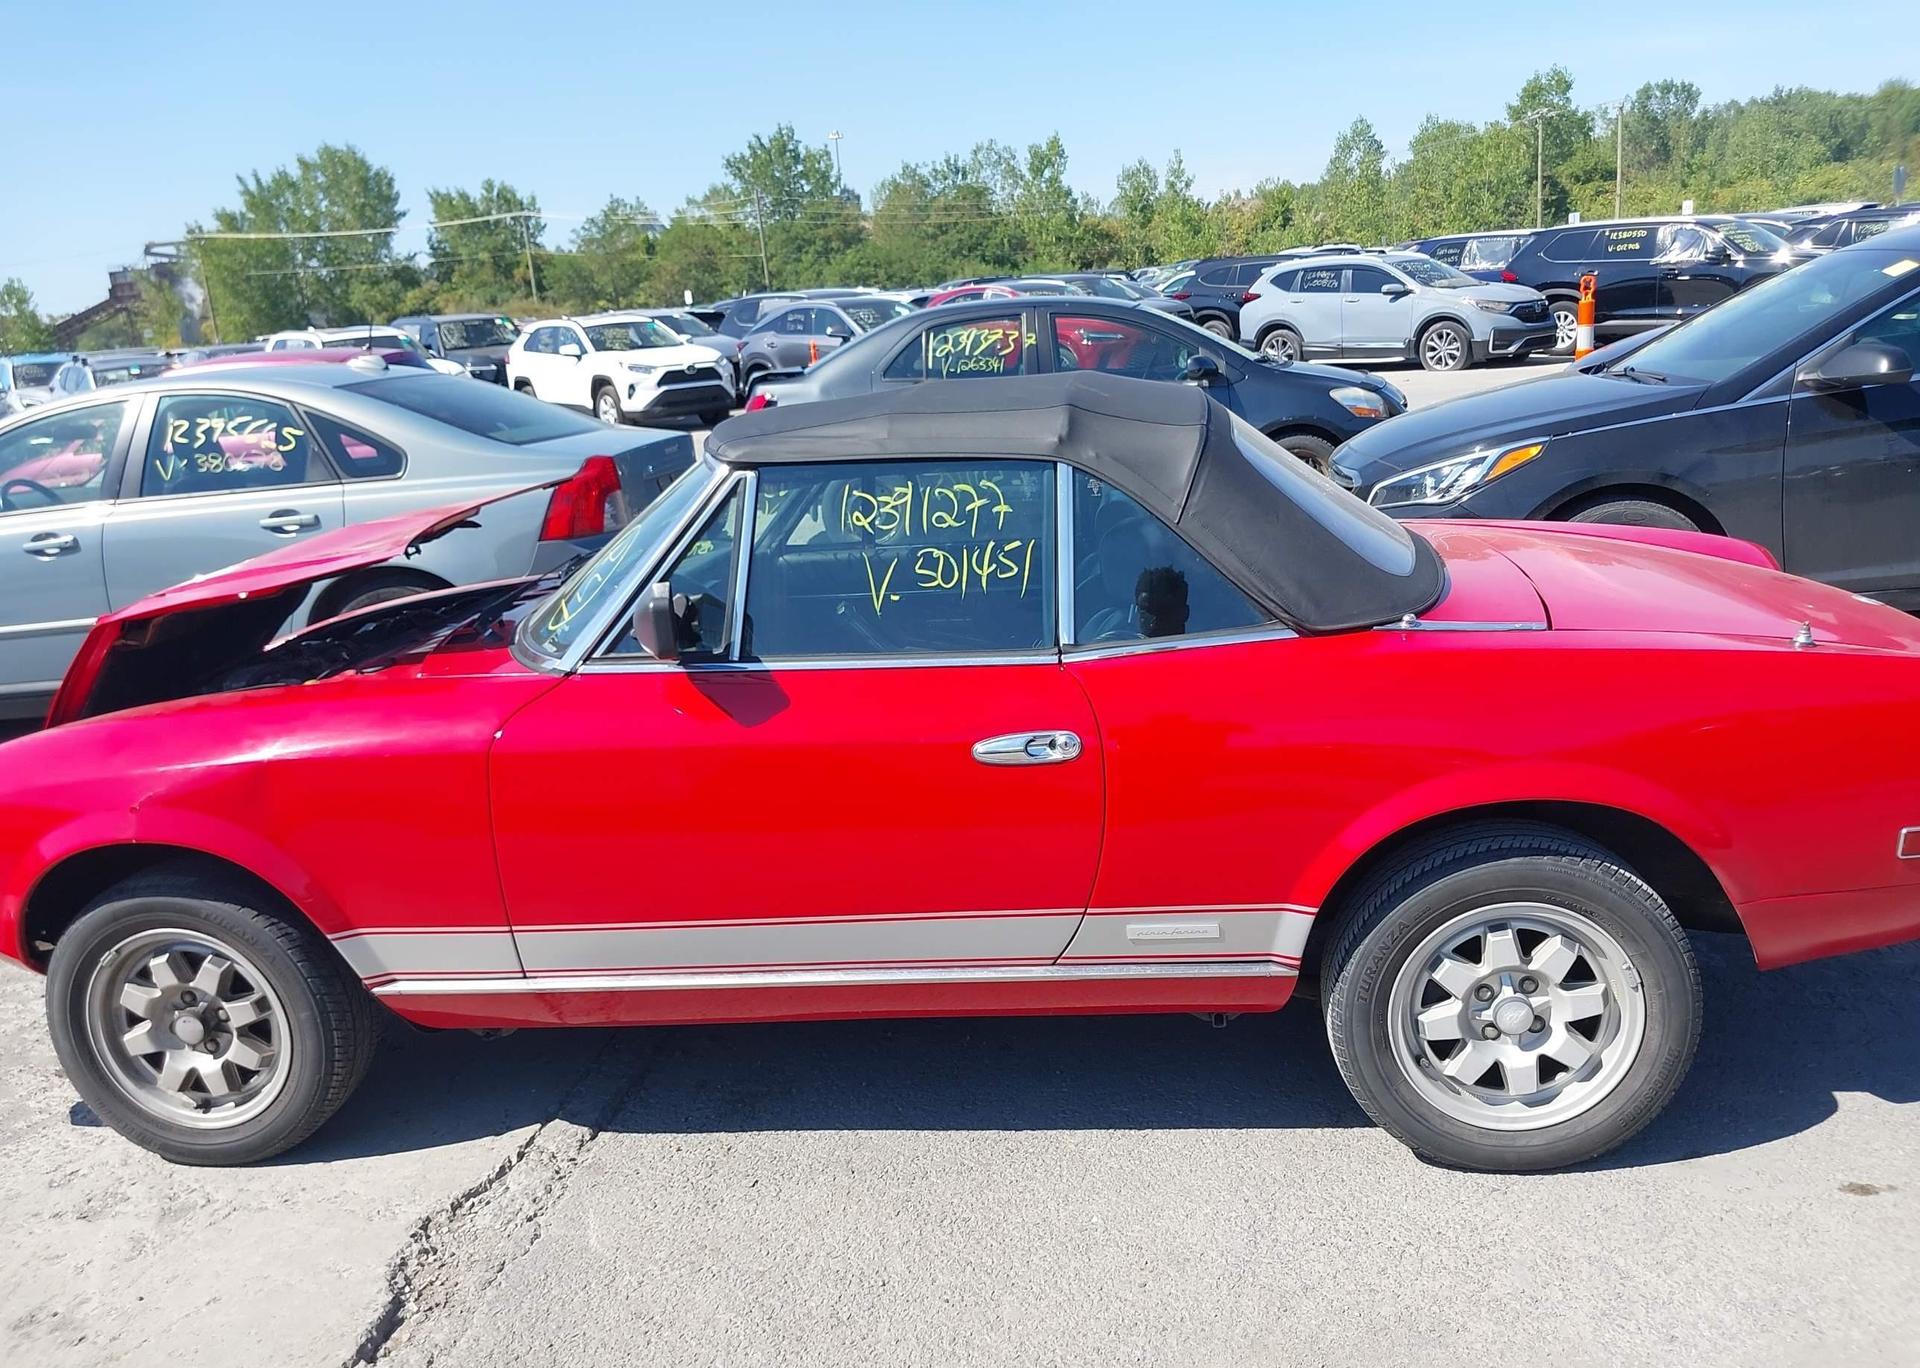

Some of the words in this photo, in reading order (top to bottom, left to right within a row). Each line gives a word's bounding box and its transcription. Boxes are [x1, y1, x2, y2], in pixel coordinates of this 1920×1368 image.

[841, 481, 1014, 539] 12391277
[914, 538, 1036, 601] 501451
[1356, 920, 1410, 1003] TURANZA
